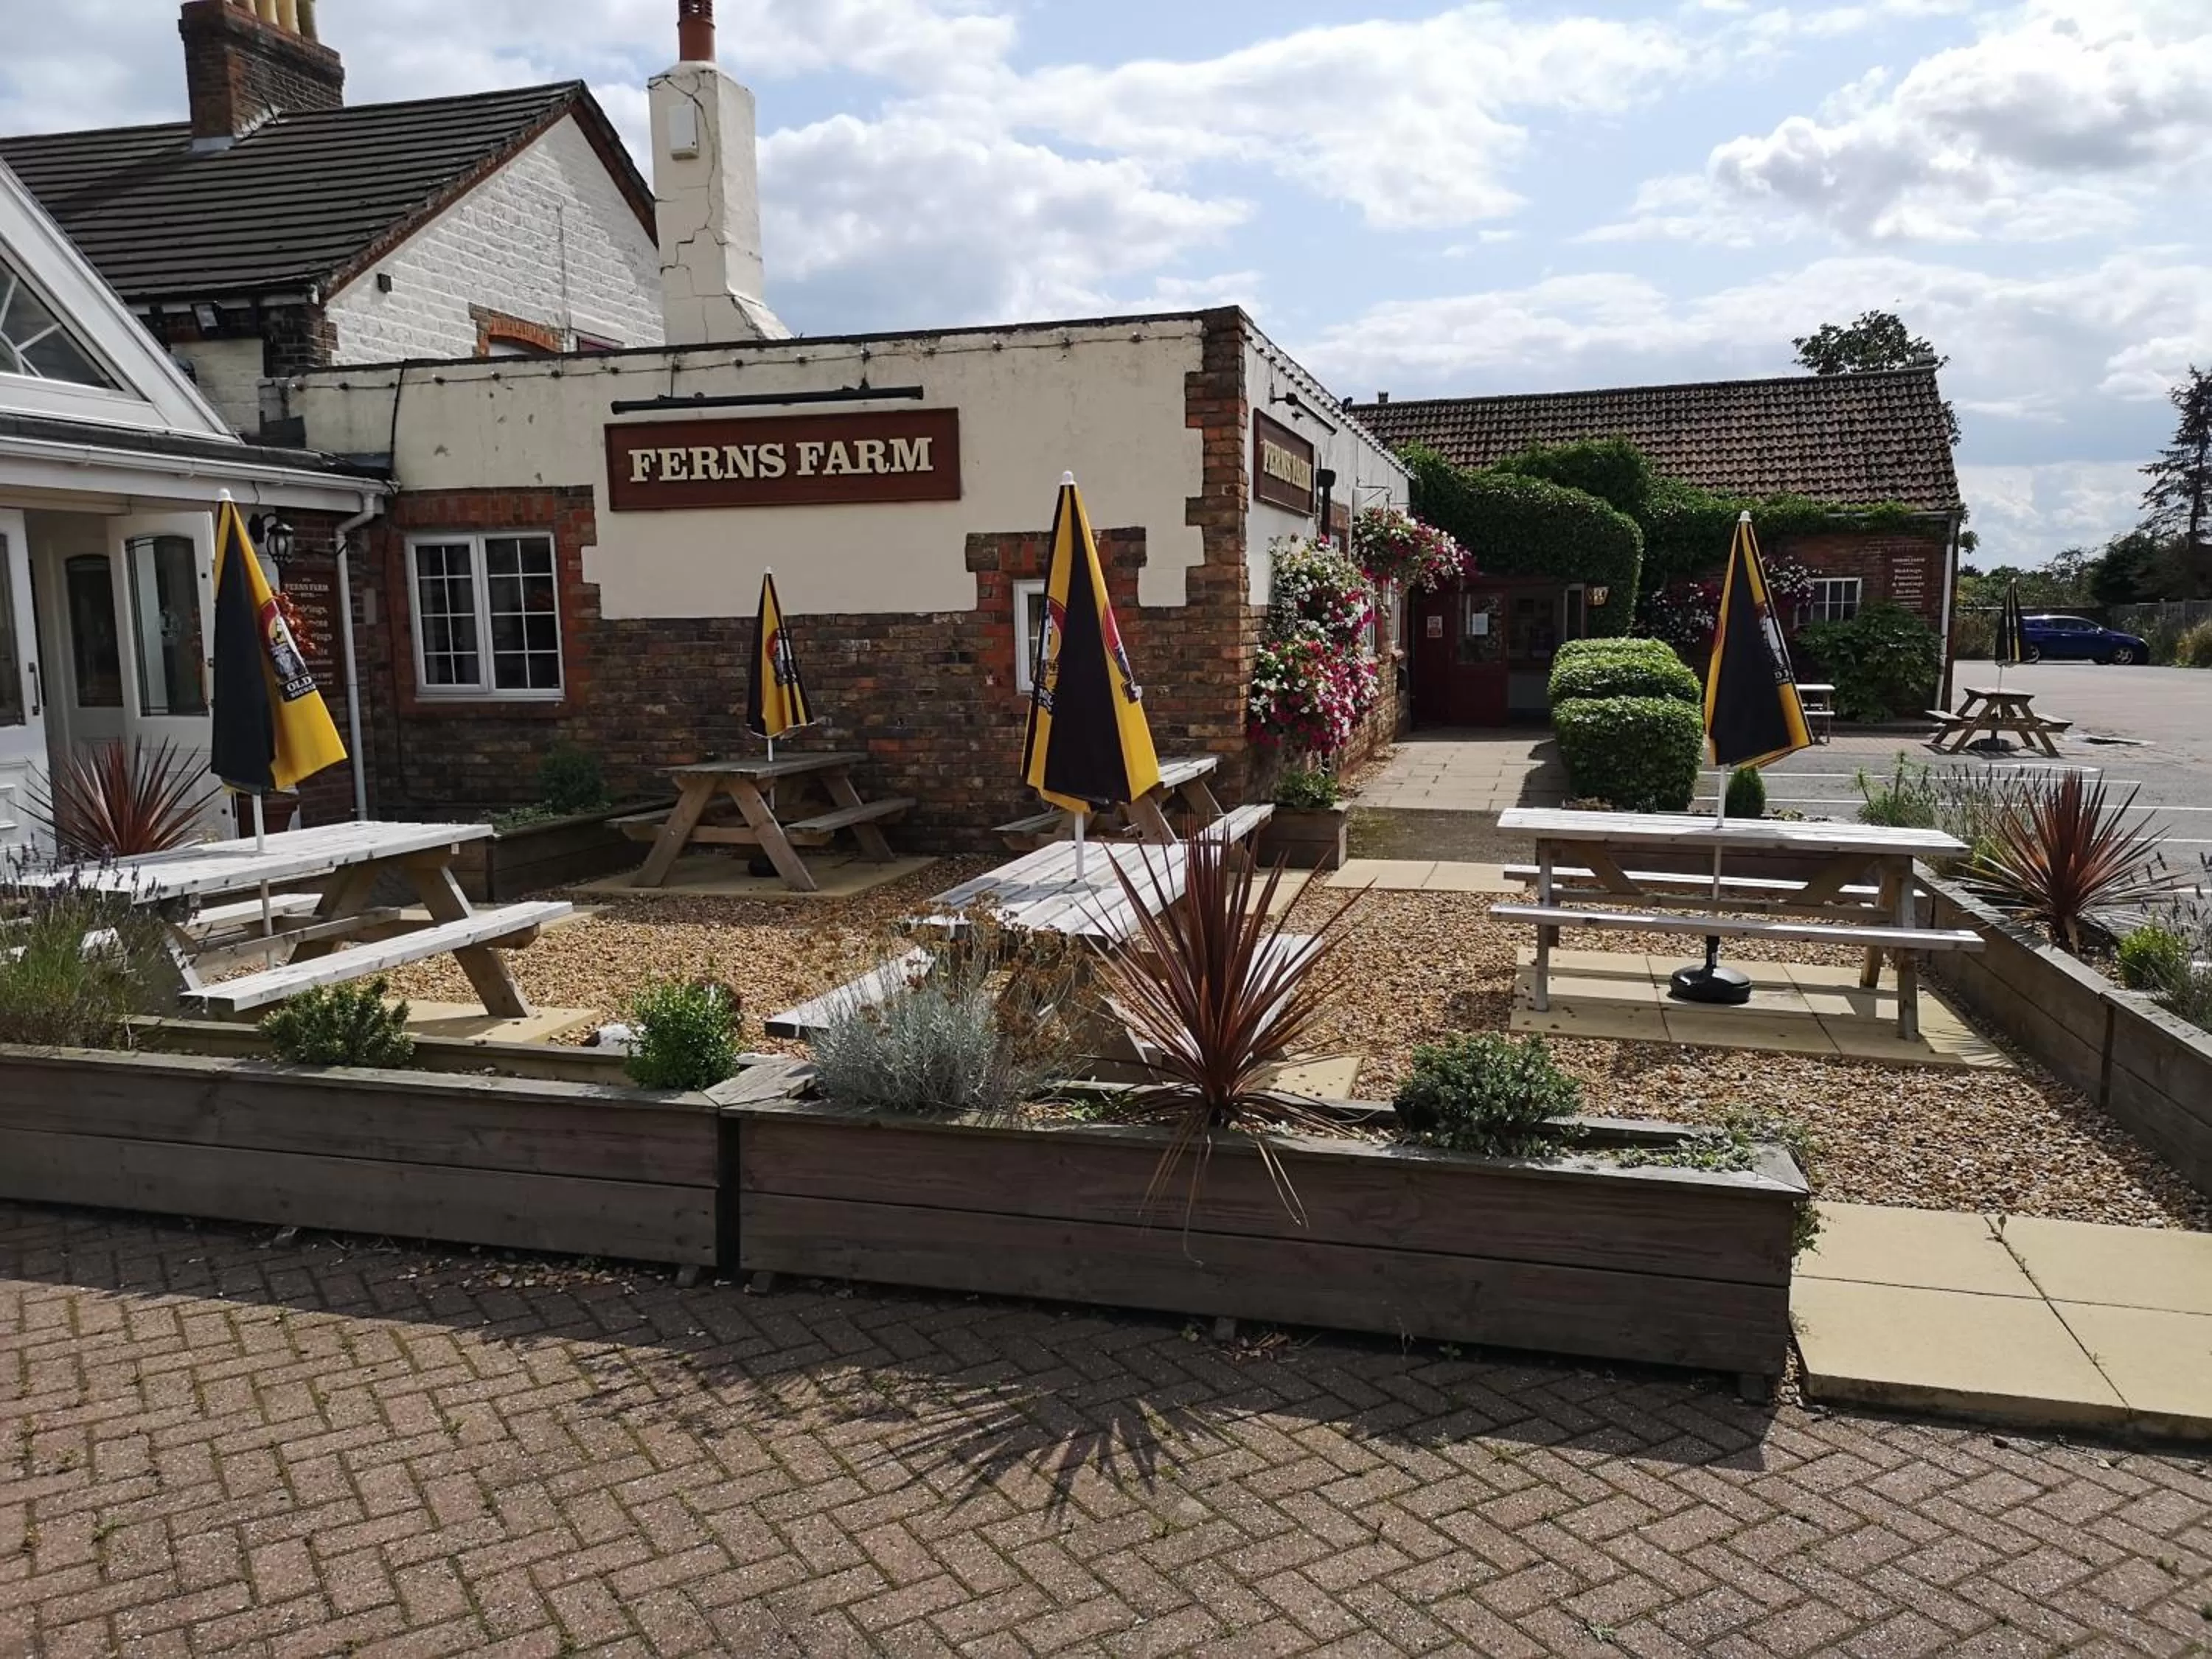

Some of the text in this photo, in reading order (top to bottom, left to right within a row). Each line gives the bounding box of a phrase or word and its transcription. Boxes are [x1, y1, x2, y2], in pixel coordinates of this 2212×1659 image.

[627, 437, 935, 483] FERNS FARM
[287, 676, 313, 692] OLD
